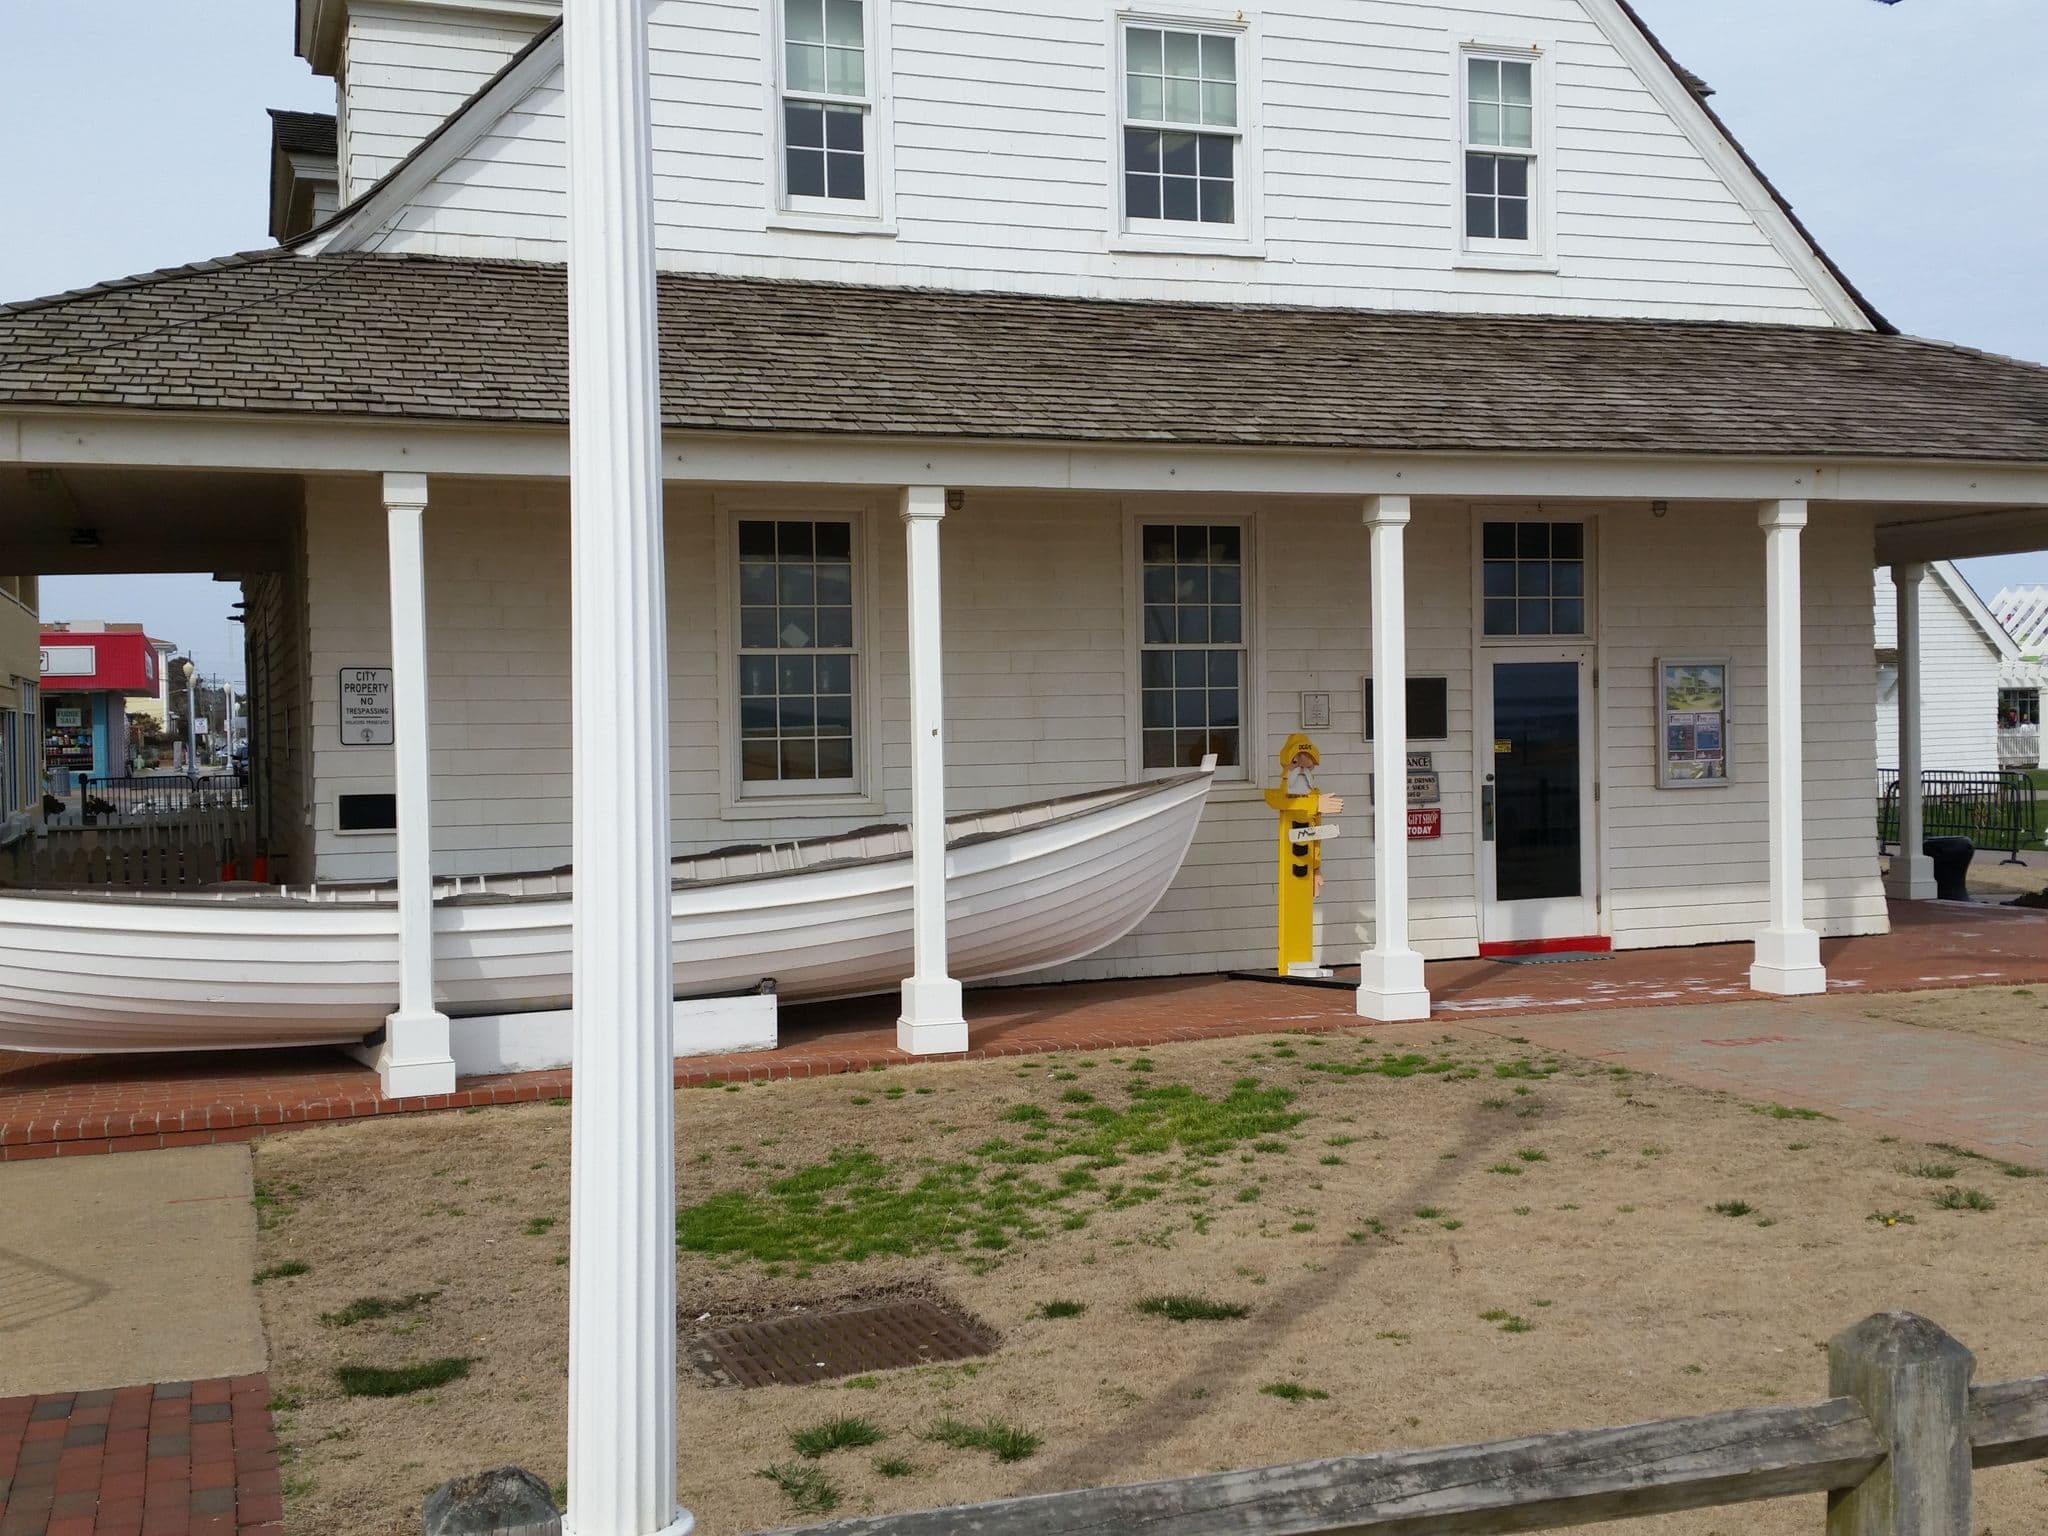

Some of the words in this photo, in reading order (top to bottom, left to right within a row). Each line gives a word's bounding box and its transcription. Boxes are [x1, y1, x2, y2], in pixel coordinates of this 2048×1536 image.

[356, 671, 376, 681] CITY
[344, 683, 389, 693] PROPERTY
[360, 697, 374, 705] NO
[346, 707, 389, 715] TRESPASSING
[1408, 814, 1422, 825] GIFT
[1422, 812, 1439, 824] SHOP
[1407, 825, 1432, 835] TODAY
